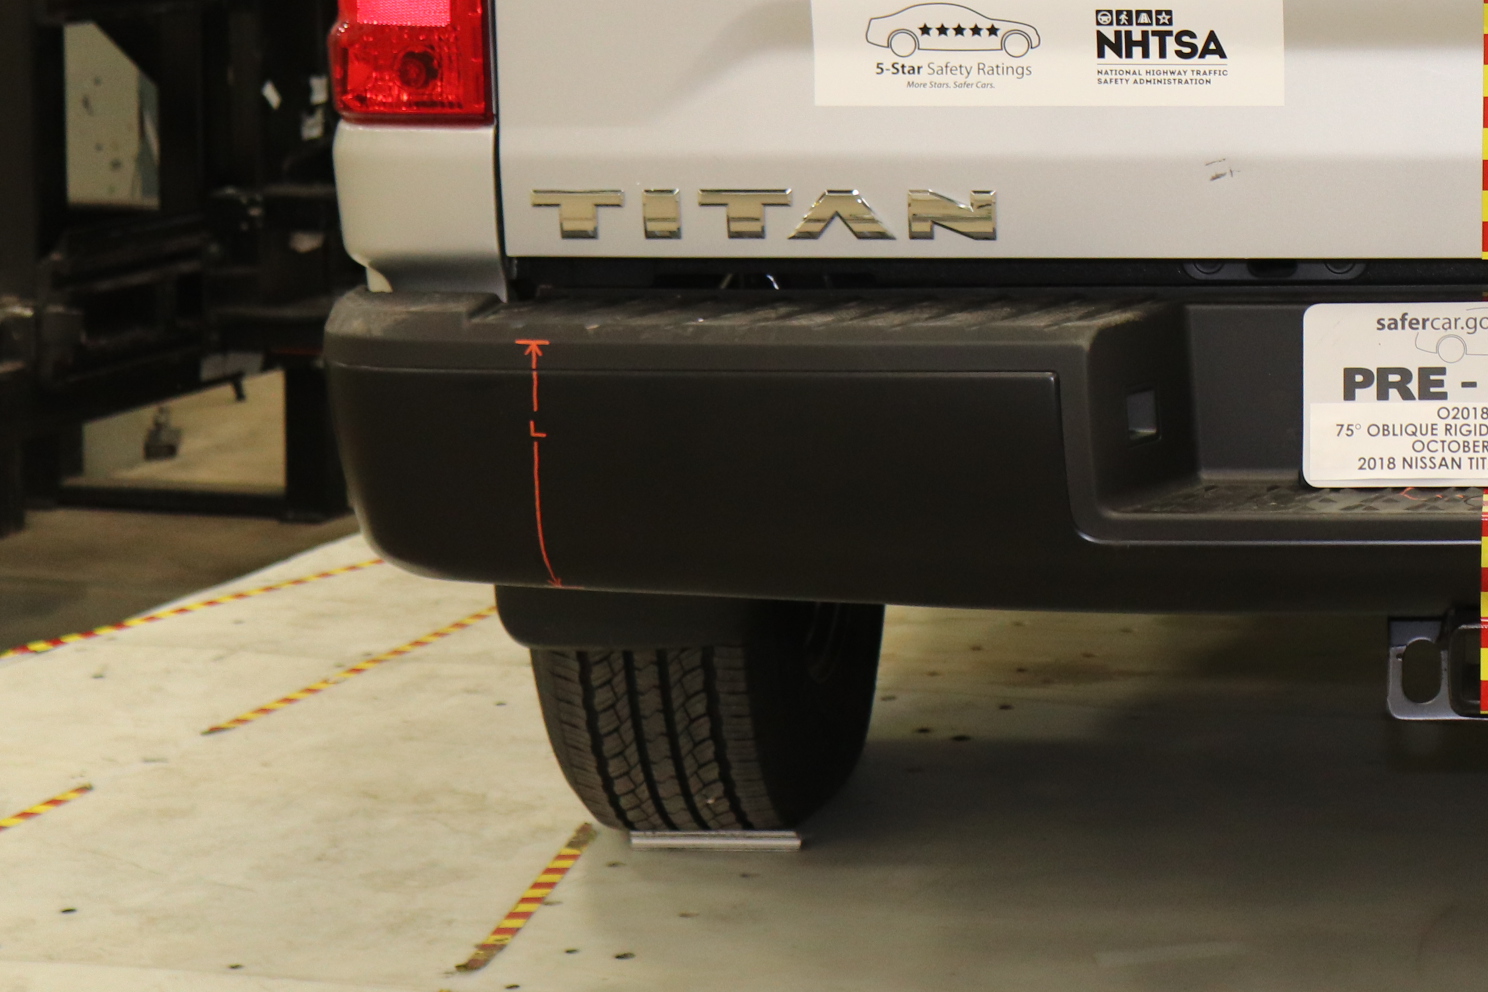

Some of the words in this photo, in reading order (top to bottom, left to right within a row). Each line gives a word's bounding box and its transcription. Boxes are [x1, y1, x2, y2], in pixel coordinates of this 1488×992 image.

[1095, 29, 1228, 60] NHTSA
[876, 61, 923, 75] 5-Star
[927, 61, 973, 79] Safety
[977, 62, 1032, 80] Ratings
[1190, 69, 1228, 77] TRAFFIC
[906, 80, 927, 89] More
[929, 80, 951, 89] Stars.
[953, 80, 974, 89] Safer
[975, 80, 995, 89] Cars.
[1097, 77, 1130, 85] SAFETY
[531, 188, 998, 240] TITAN
[1343, 366, 1449, 402] PRE
[1366, 422, 1438, 438] OBLIQUE
[1357, 456, 1397, 471] 2018
[1402, 456, 1462, 470] NISSAN
